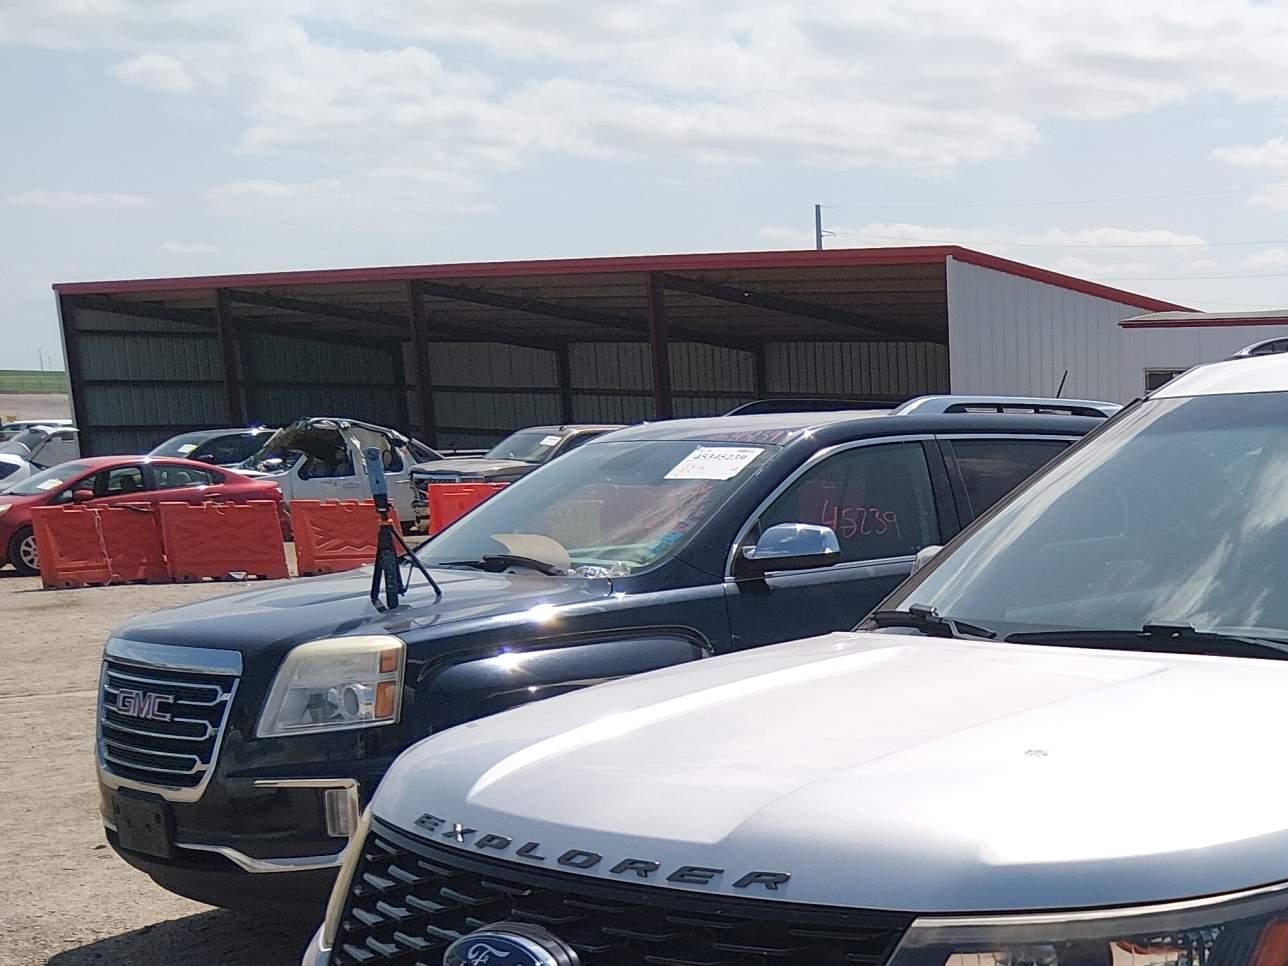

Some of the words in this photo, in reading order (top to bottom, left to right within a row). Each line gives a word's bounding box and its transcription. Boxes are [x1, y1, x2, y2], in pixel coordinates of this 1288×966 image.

[820, 499, 902, 539] 45239
[116, 688, 175, 722] GMC
[414, 813, 793, 891] EXPLORER
